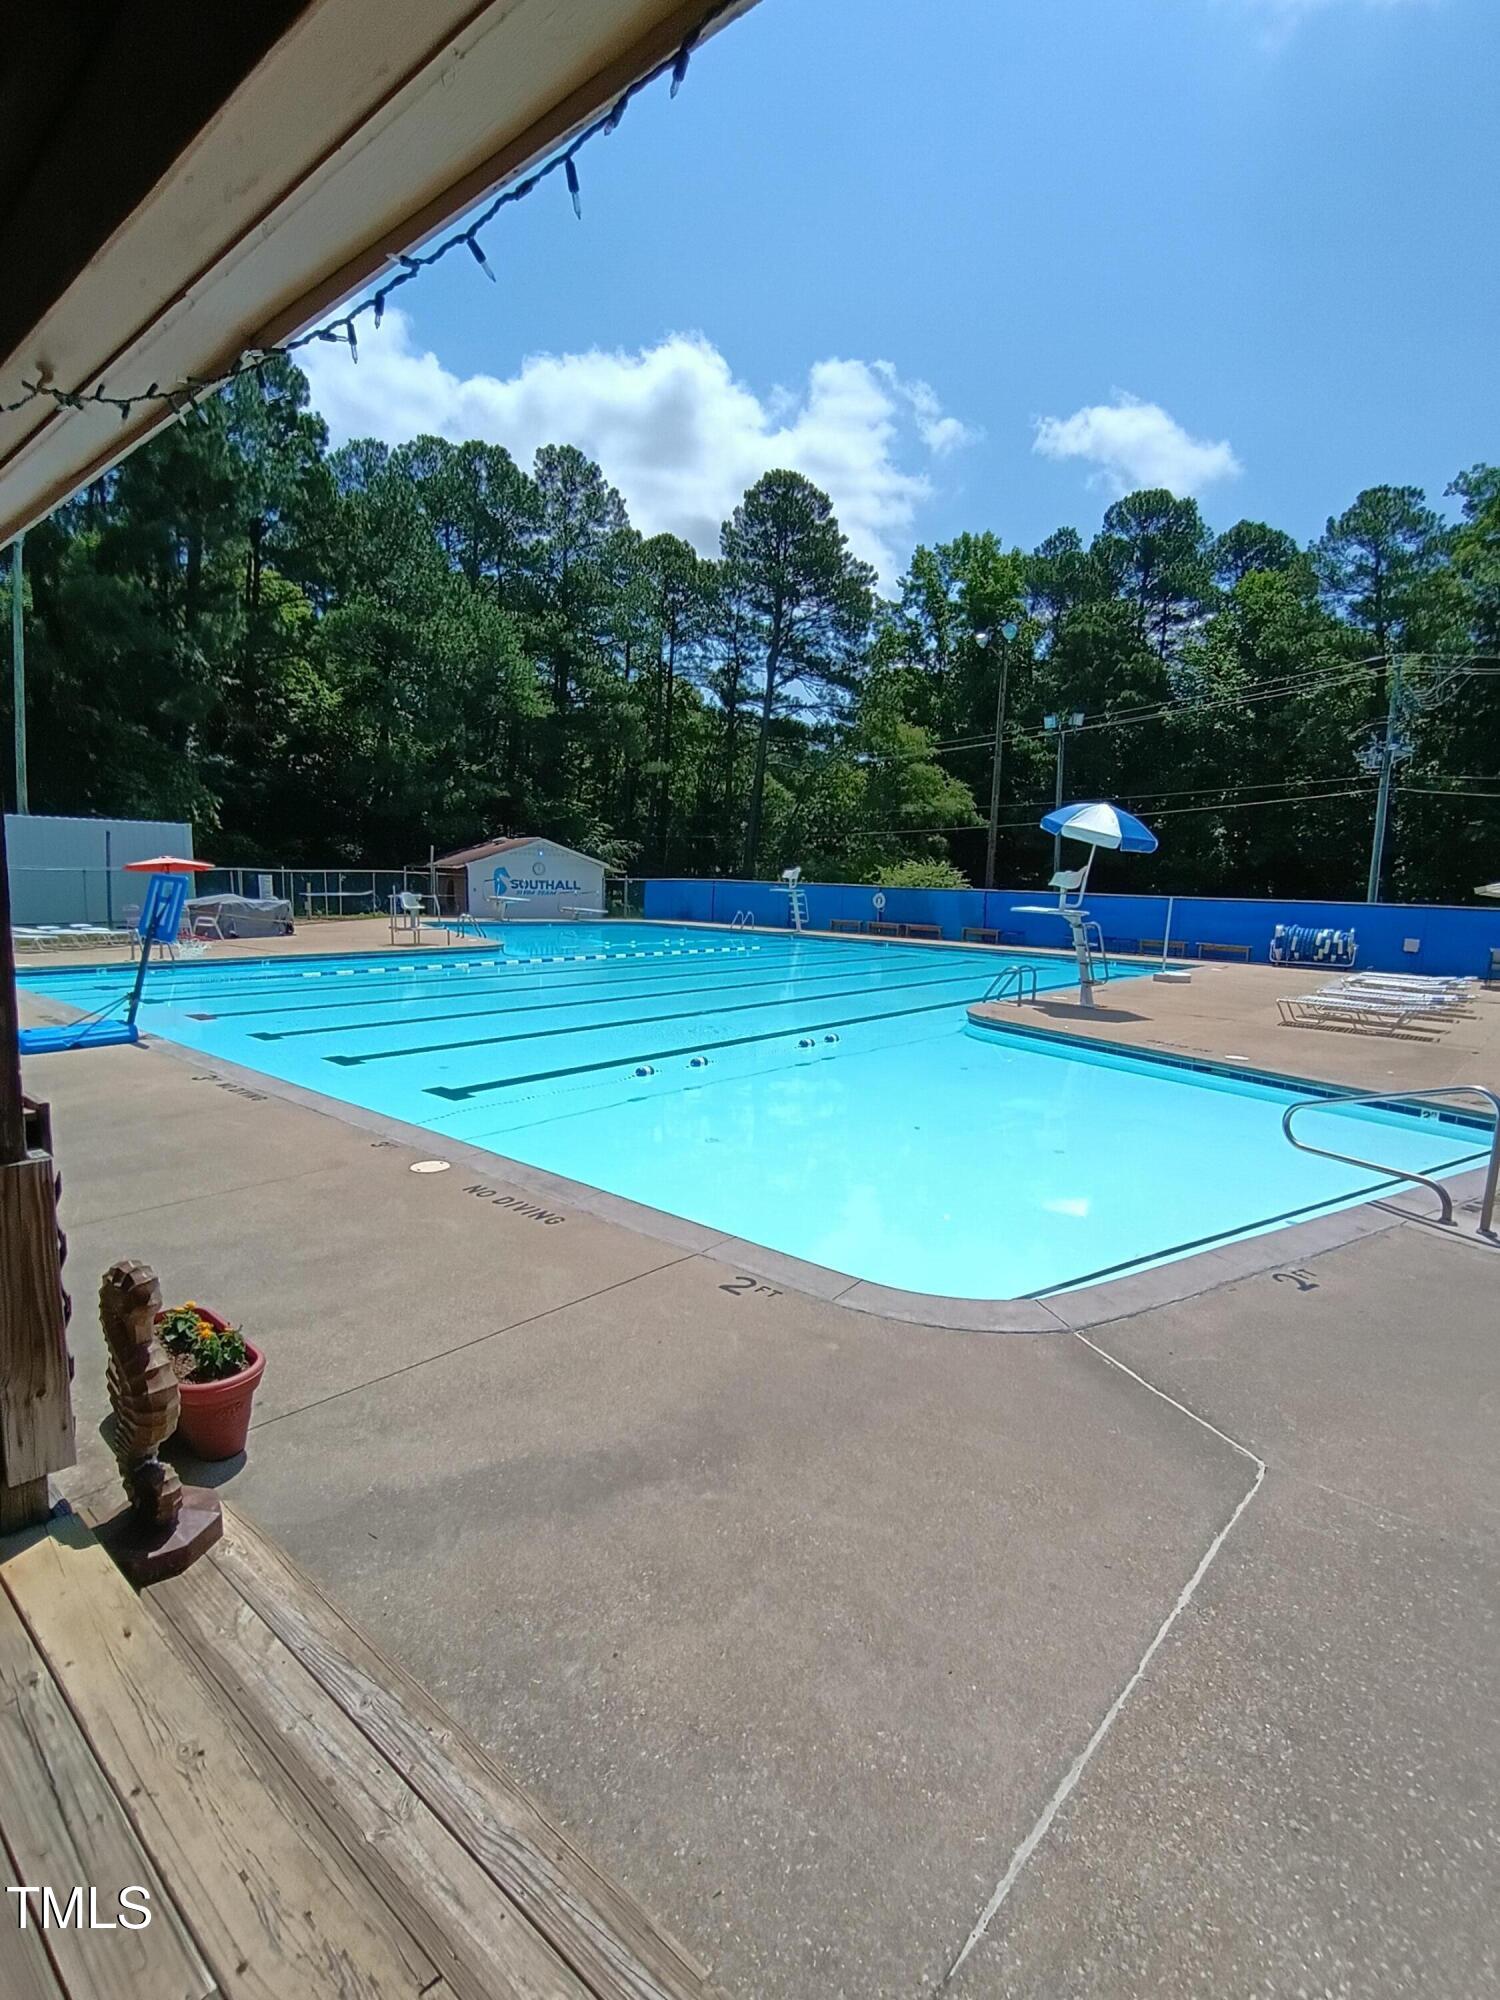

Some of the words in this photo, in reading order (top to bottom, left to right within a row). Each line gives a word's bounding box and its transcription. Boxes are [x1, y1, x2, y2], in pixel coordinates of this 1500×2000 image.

[510, 879, 581, 890] SOUTHALL
[462, 1184, 497, 1198] NO
[492, 1196, 566, 1226] DIVING
